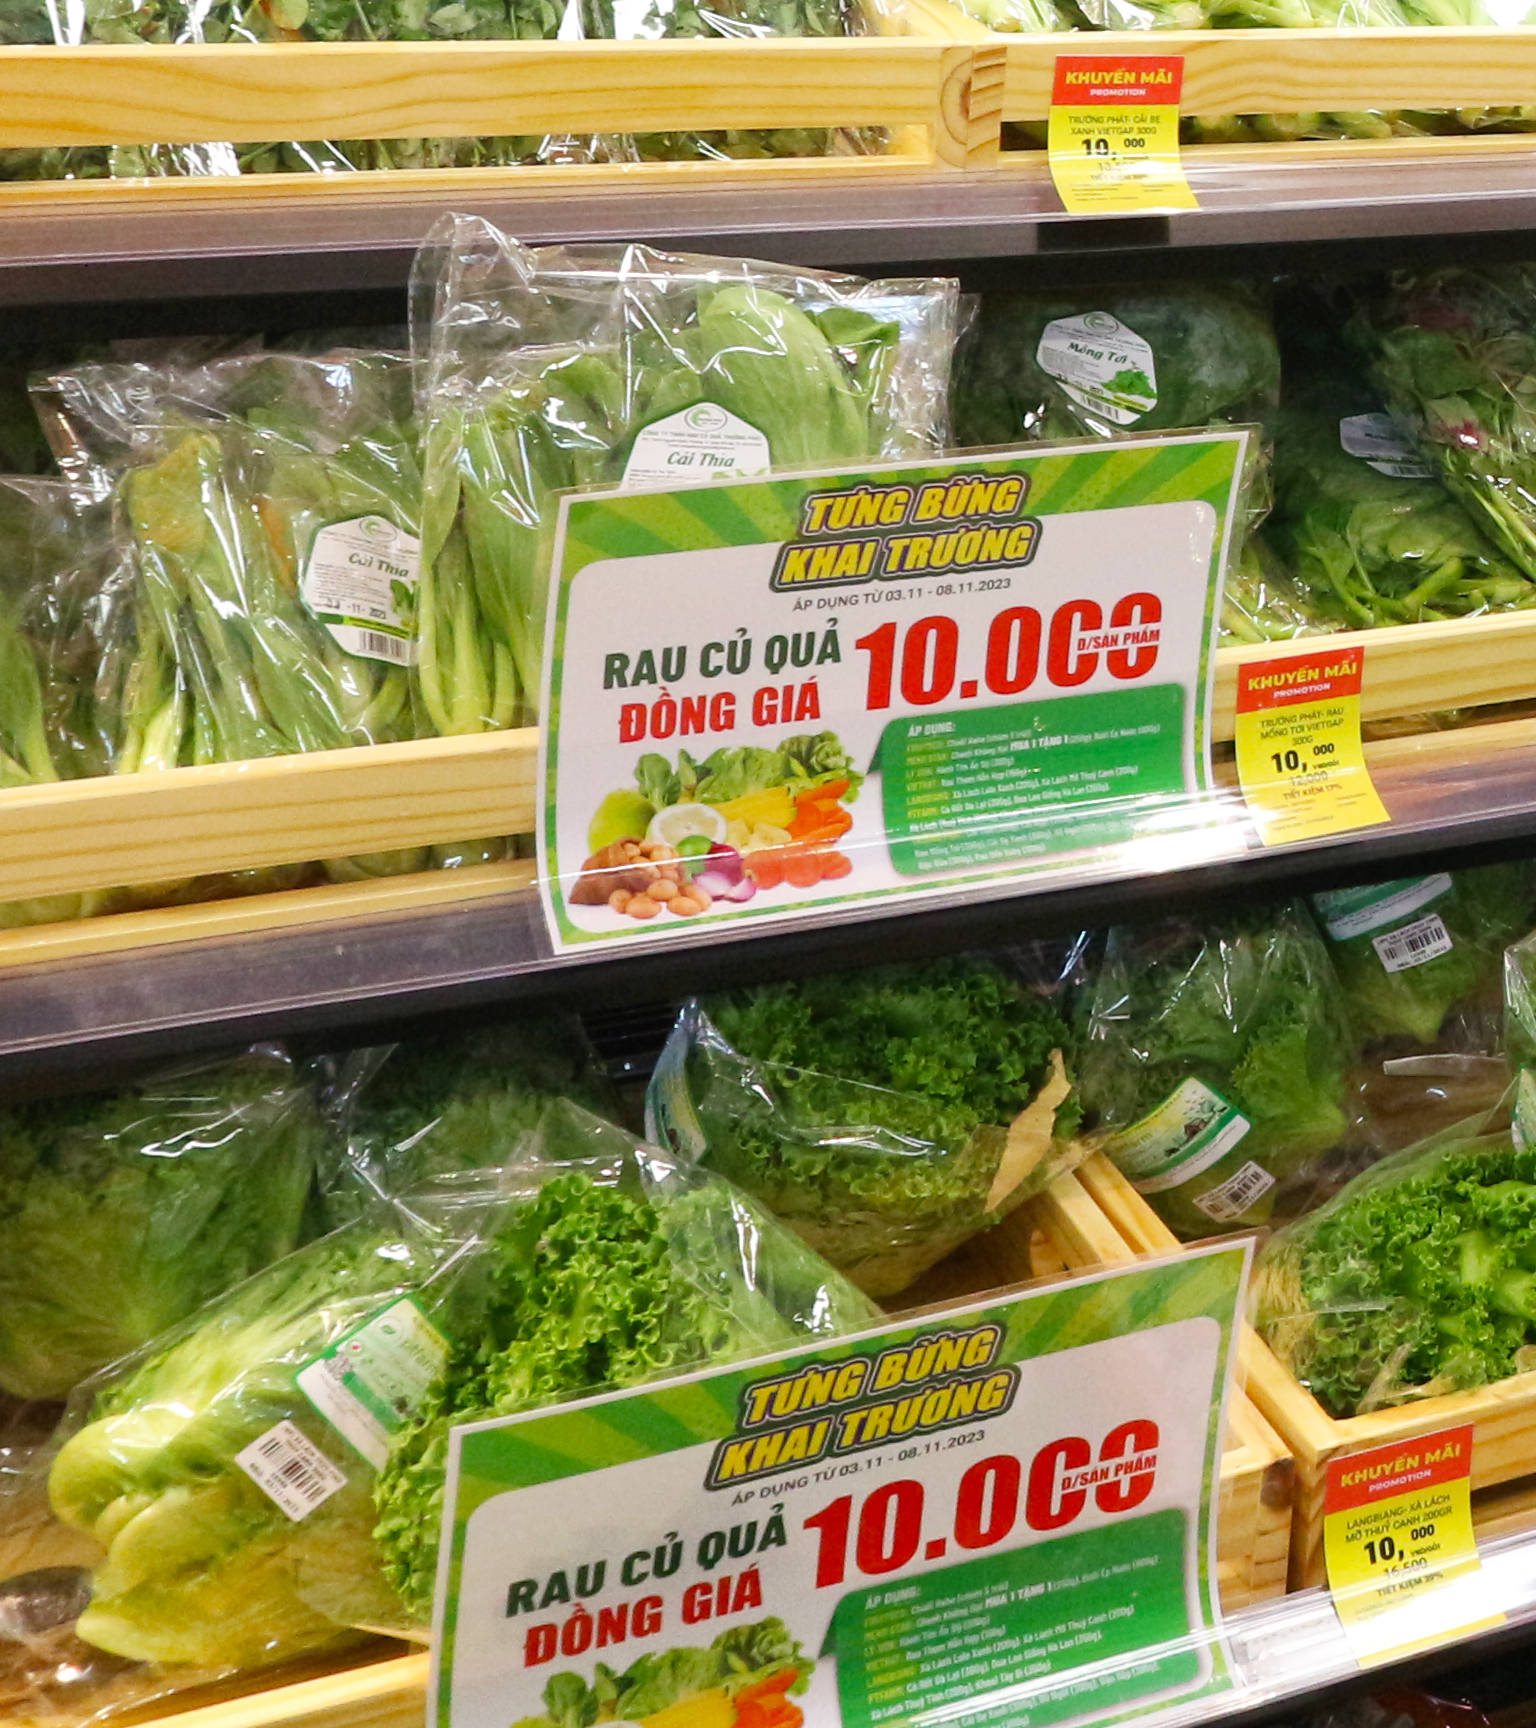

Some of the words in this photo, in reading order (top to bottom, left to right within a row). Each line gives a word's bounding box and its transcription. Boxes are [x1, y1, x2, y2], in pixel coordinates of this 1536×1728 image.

[1065, 68, 1136, 84] KHUYẾN
[1140, 68, 1172, 84] MÃI
[1090, 88, 1146, 96] PROMOTION
[808, 489, 910, 533] TƯNG
[913, 476, 1023, 522] BỪNG
[779, 540, 878, 584] KHAI
[883, 522, 1035, 573] TRƯƠNG
[793, 596, 813, 612] ÁP
[816, 594, 859, 610] DỤNG
[863, 587, 883, 604] TỪ
[885, 588, 922, 602] 03.11
[936, 578, 1011, 597] 08.11.2023
[603, 648, 686, 691] RAU
[698, 627, 752, 679] CỦ
[764, 618, 842, 678] QUẢ
[1248, 664, 1320, 692] KHUYẾN
[1324, 659, 1358, 678] MÃI
[618, 685, 736, 744] ĐỒNG
[752, 675, 822, 728] GIÁ
[1273, 682, 1332, 699] PROMOTION
[1271, 749, 1308, 773] 10,
[1313, 743, 1336, 756] 000
[748, 1361, 867, 1424] TƯNG
[873, 1328, 998, 1392] BỪNG
[716, 1418, 831, 1482] KHAI
[837, 1372, 1011, 1449] TRƯƠNG
[731, 1489, 755, 1507] ÁP
[759, 1476, 809, 1501] DỤNG
[814, 1467, 836, 1484] TỪ
[838, 1455, 883, 1478] 03.11
[898, 1428, 985, 1461] 08.11.2023
[1341, 1452, 1420, 1488] KHUYẾN
[1425, 1441, 1461, 1466] MÃI
[1369, 1468, 1433, 1494] PROMOTION
[1423, 1493, 1450, 1509] LÁCH
[1363, 1535, 1405, 1566] 10,
[1411, 1524, 1435, 1542] 000
[1392, 1516, 1421, 1532] CANH
[506, 1558, 607, 1619] RAU
[619, 1530, 684, 1589] CỦ
[695, 1503, 789, 1574] QUẢ
[523, 1596, 666, 1670] ĐỒNG
[681, 1563, 763, 1627] GIÁ
